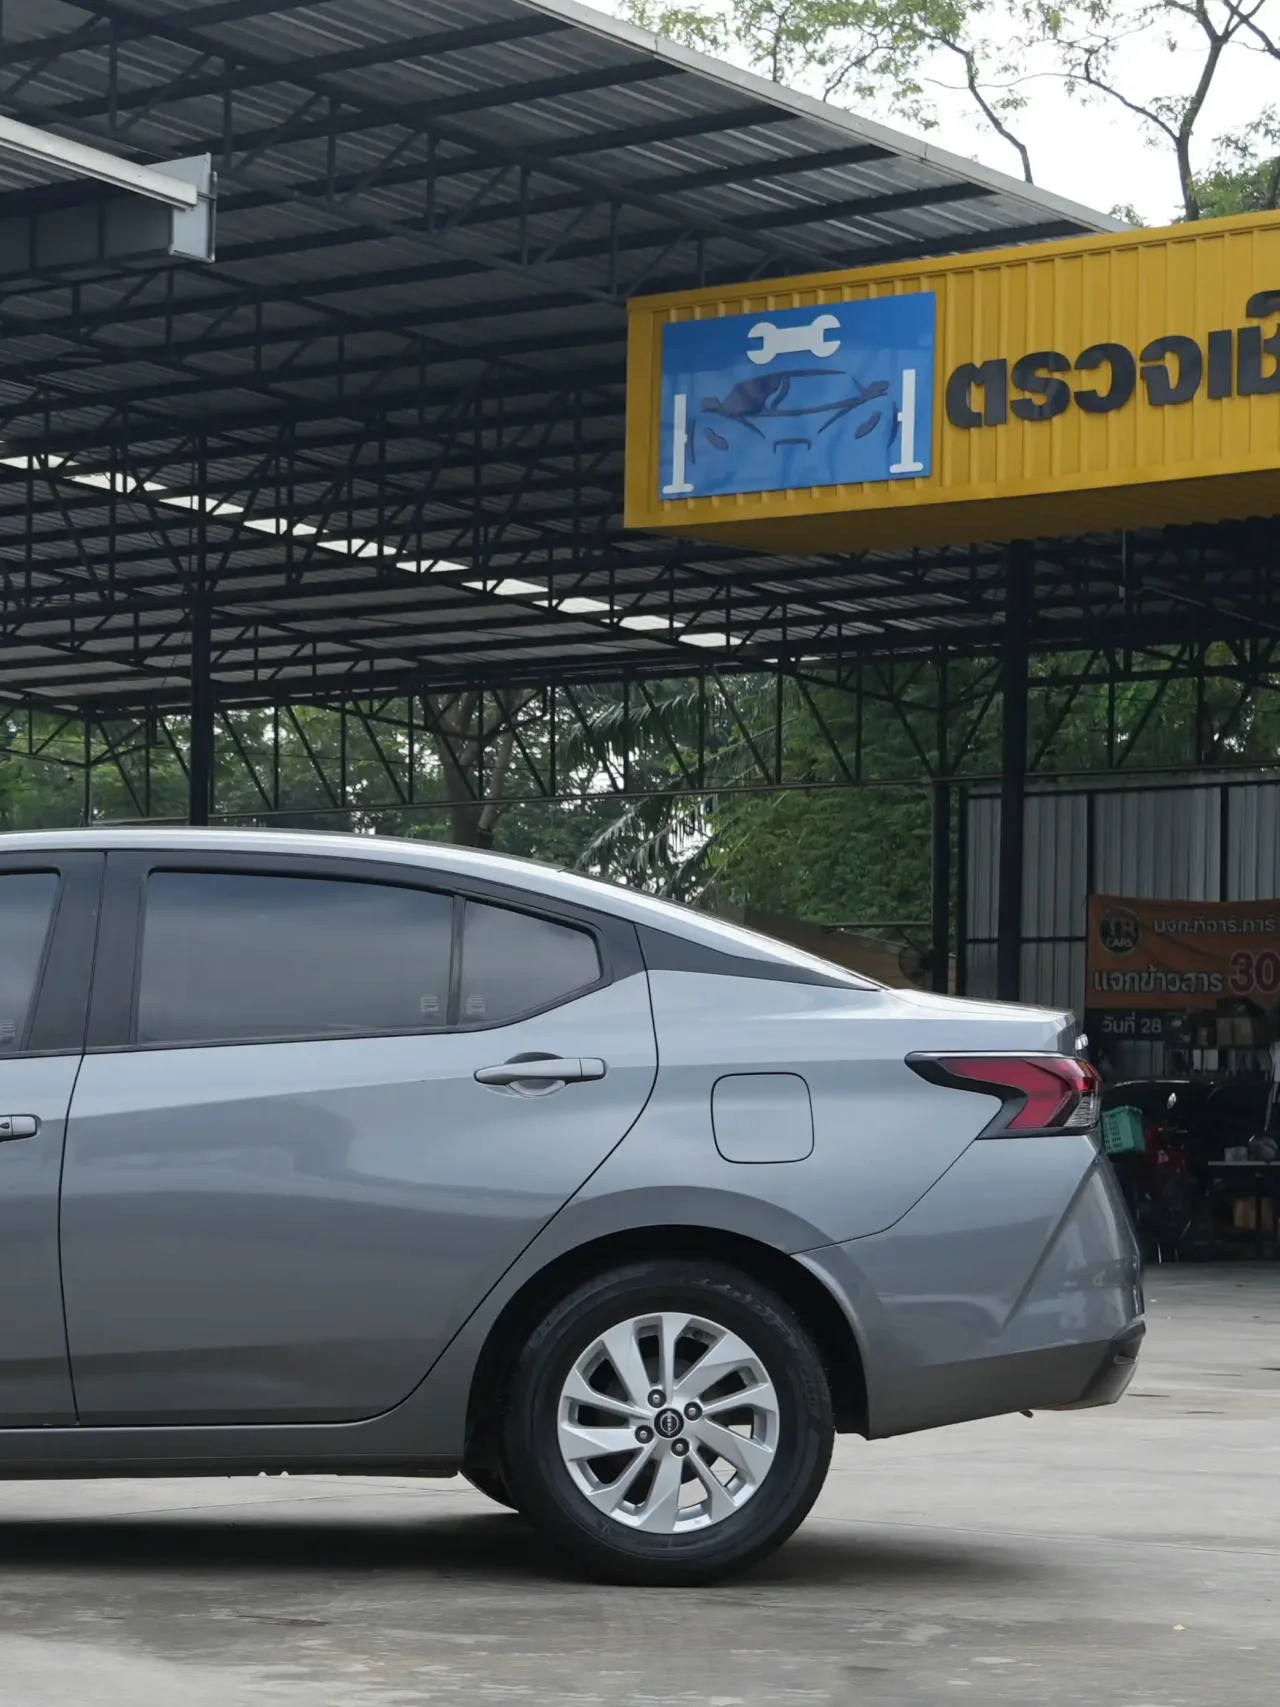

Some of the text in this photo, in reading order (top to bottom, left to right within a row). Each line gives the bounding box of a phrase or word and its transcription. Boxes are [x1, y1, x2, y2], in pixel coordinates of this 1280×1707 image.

[1094, 964, 1224, 993] แจกข้าวสาร
[1102, 1012, 1162, 1034] วันที่ 28
